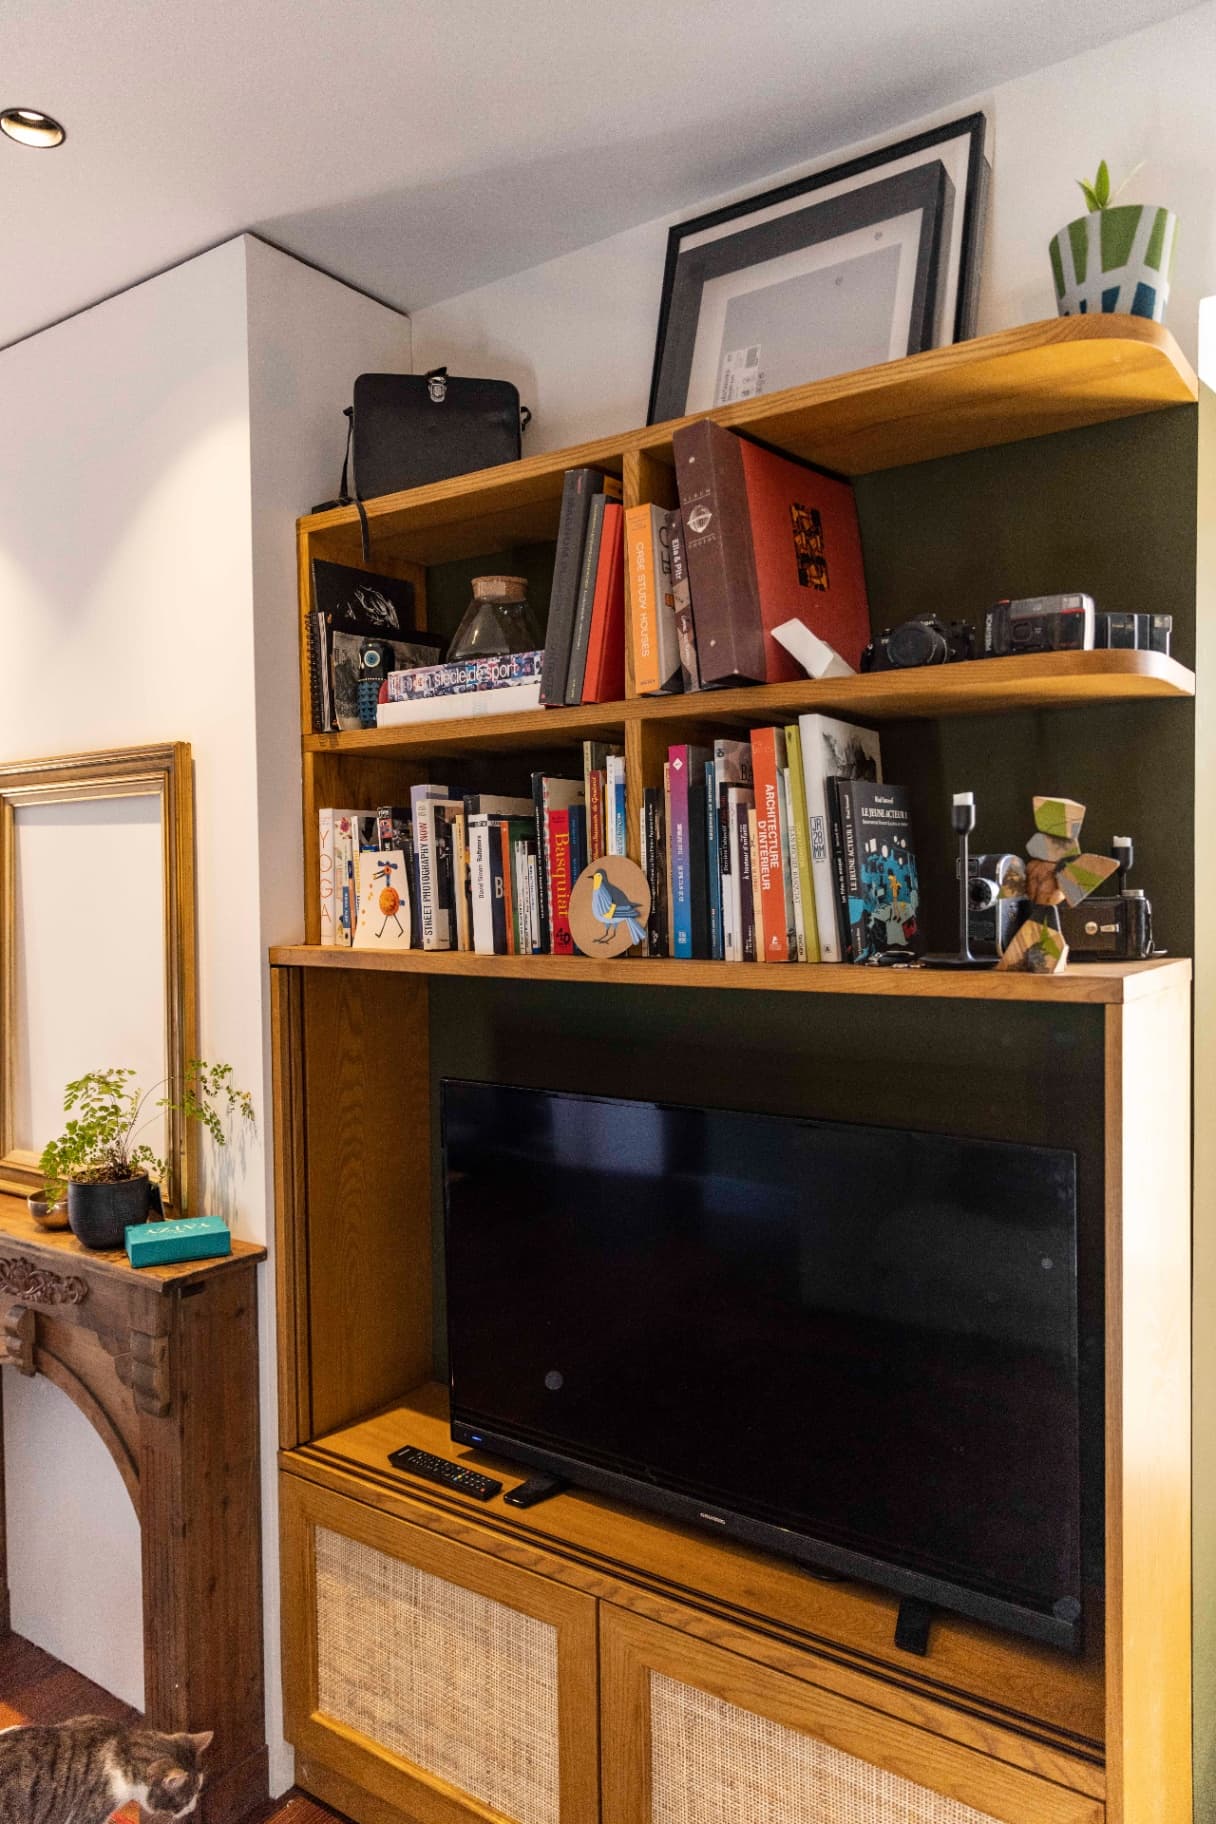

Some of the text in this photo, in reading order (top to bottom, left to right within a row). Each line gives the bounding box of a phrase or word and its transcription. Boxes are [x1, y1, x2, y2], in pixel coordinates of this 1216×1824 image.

[635, 541, 650, 657] CASE STUDY HOUSES
[469, 664, 483, 682] de
[486, 661, 519, 682] sport
[764, 784, 779, 869] ARCHITECTURE
[812, 817, 822, 831] JR
[861, 807, 869, 817] LE
[868, 807, 884, 818] JEUNE
[418, 822, 428, 842] NOW
[813, 831, 823, 845] 28
[846, 829, 856, 857] ACTEUR
[757, 820, 772, 891] D'INTÉRIEUR
[848, 856, 857, 881] JEUNE
[319, 830, 333, 922] YOGA
[419, 843, 432, 903] PHOTOGRAPHY
[552, 832, 570, 915] Basquiat
[850, 881, 858, 891] LE
[421, 905, 433, 936] STREET
